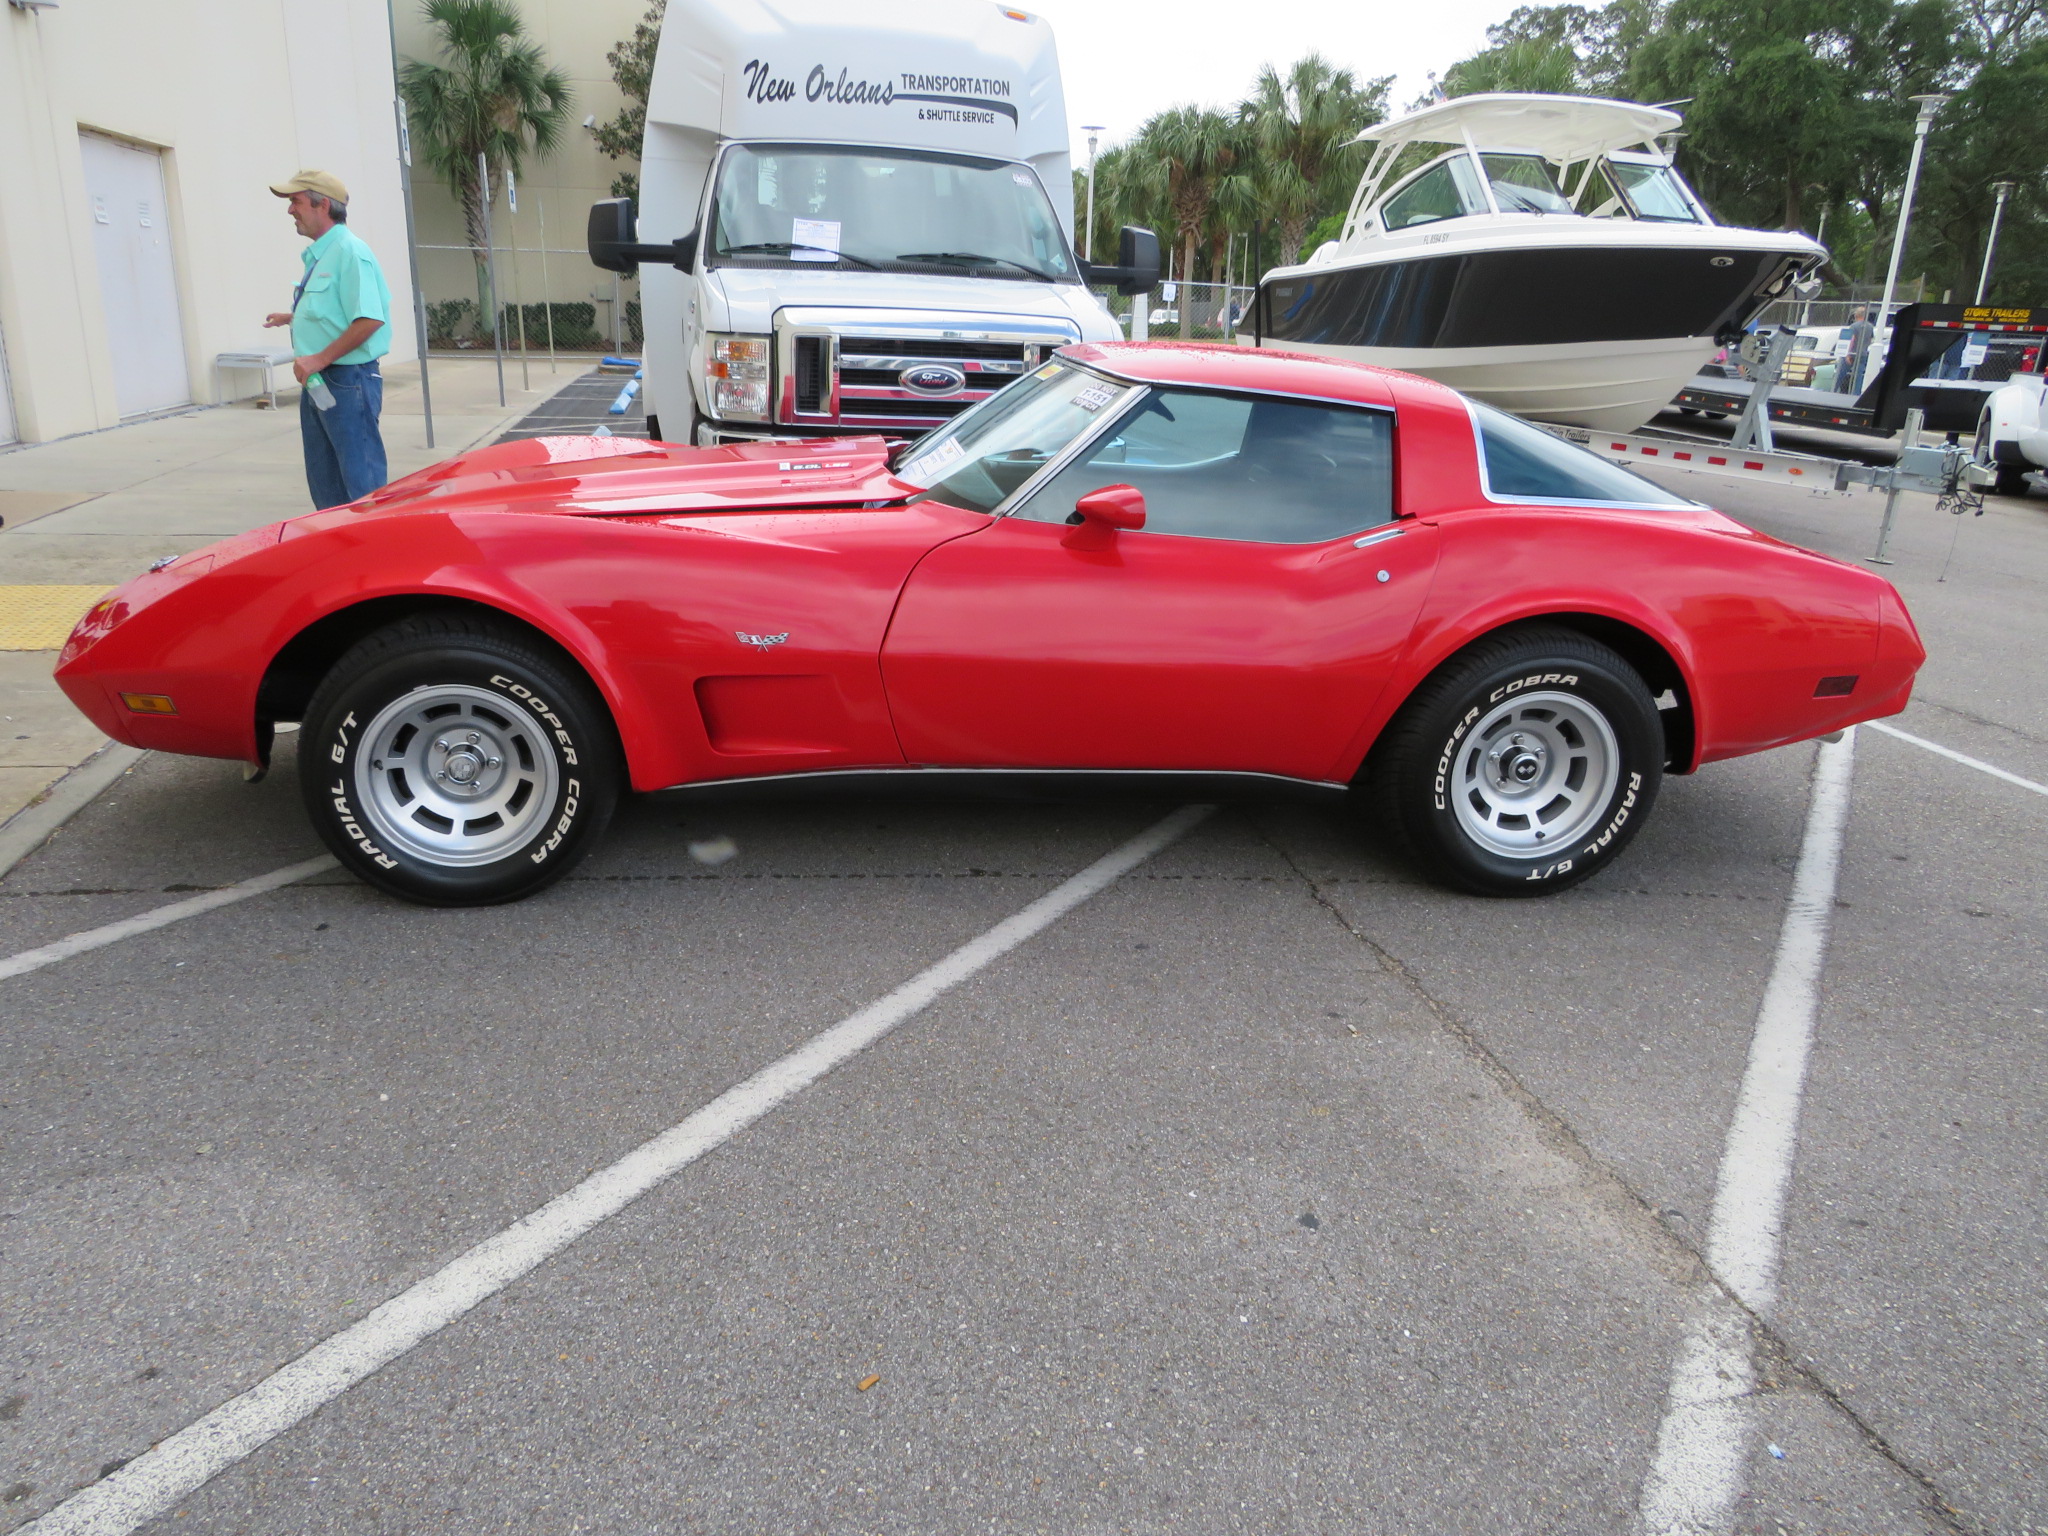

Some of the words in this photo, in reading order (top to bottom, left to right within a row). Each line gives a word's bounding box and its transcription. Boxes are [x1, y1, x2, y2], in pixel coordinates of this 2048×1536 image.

[743, 59, 796, 104] New
[805, 63, 893, 106] Orleans
[900, 73, 1010, 97] TRANSPORTATION
[918, 109, 925, 121] &
[926, 109, 961, 122] SHUTTLE
[962, 111, 995, 124] SERVICE
[1963, 307, 1991, 317] STONE
[1991, 308, 2031, 318] TRAILERS
[919, 372, 949, 385] Ford
[1101, 385, 1118, 396] NOT
[331, 711, 358, 764] G/T
[490, 674, 579, 766] COOPER
[1434, 706, 1480, 810] COOPER
[1489, 673, 1579, 703] COBRA
[330, 778, 399, 870] RADIAL
[530, 778, 581, 864] COBRA
[1583, 771, 1642, 855] RADIAL
[1526, 859, 1574, 881] G/T
